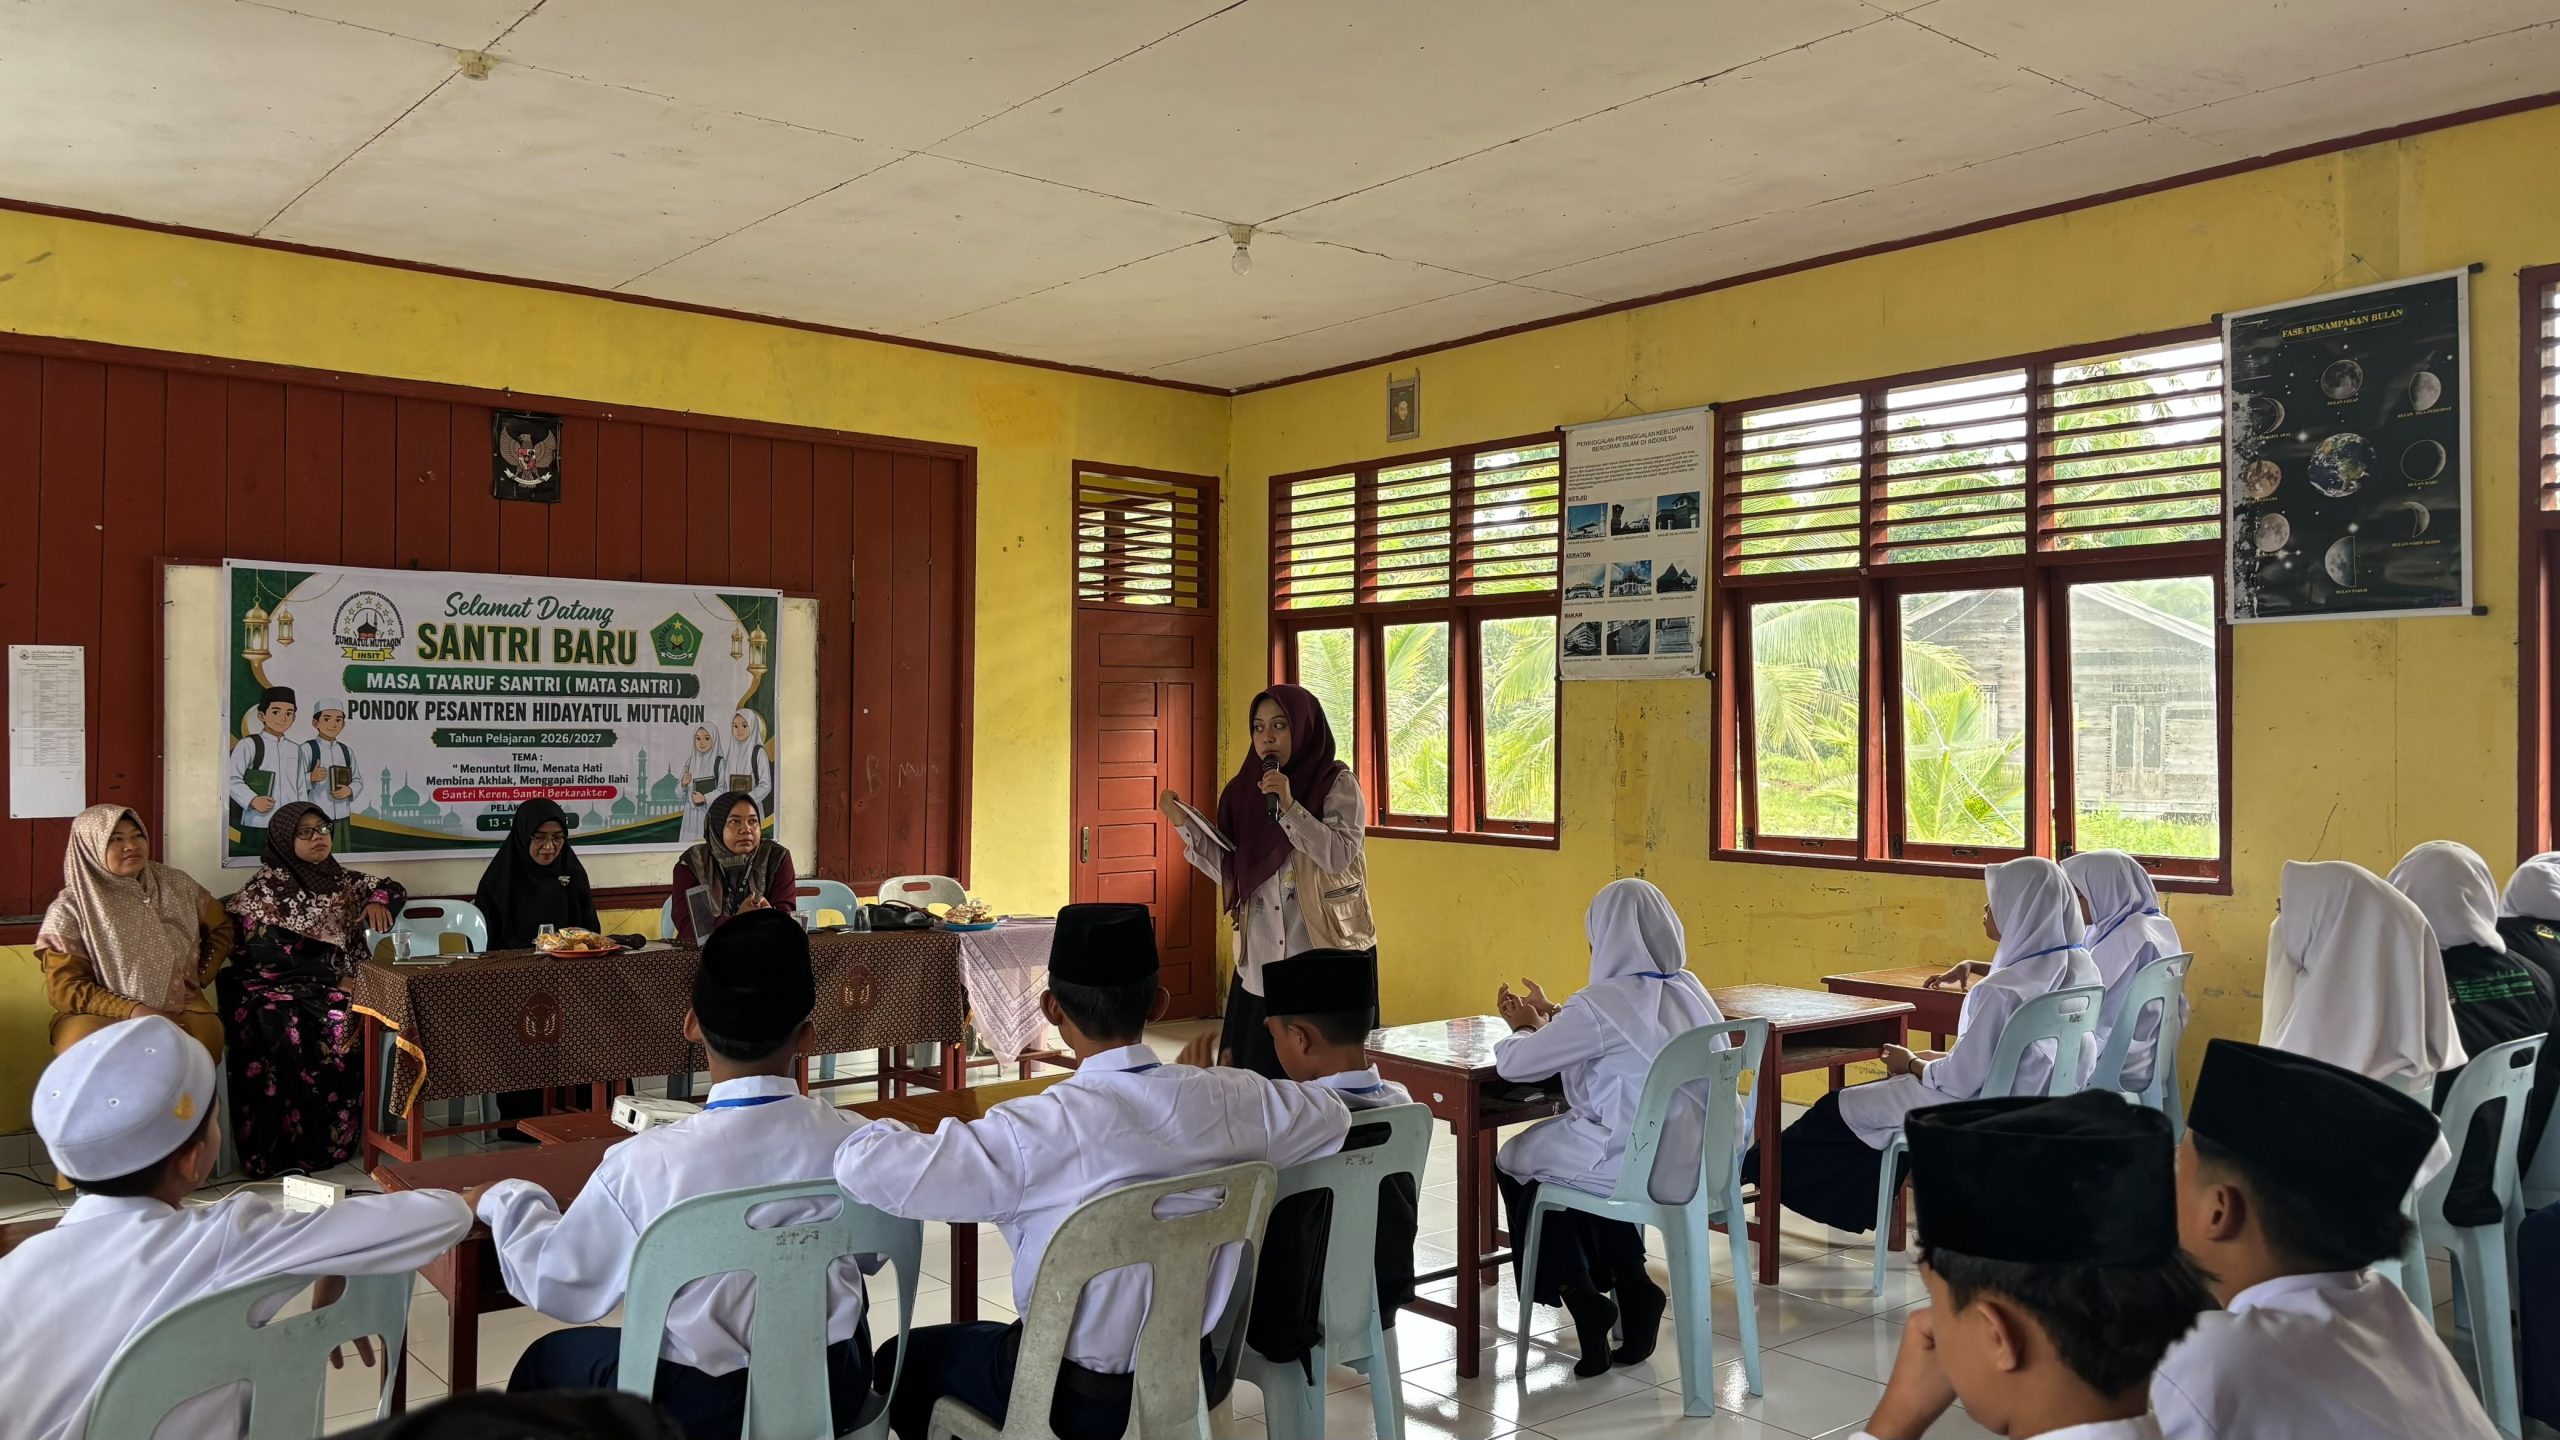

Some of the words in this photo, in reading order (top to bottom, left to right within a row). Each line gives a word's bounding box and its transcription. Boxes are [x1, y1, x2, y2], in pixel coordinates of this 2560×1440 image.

[2281, 327, 2304, 338] FASE
[2305, 315, 2369, 334] PENAMPAKAN
[2371, 308, 2404, 322] BULAN
[444, 591, 533, 618] Selamat
[536, 595, 615, 629] Datang
[335, 635, 369, 647] ZUMRATUL
[417, 623, 541, 663] SANTRI
[554, 627, 638, 666] BARU
[366, 672, 421, 689] MASA
[500, 675, 560, 692] SANTRI
[575, 677, 617, 693] MATA
[620, 678, 673, 695] SANTRI
[347, 699, 419, 721] PONDOK
[425, 700, 527, 722] PESANTREN
[532, 702, 622, 722] HIDAYATUL
[627, 704, 705, 725] MUTTAQIN
[449, 733, 483, 744] Tahun
[486, 733, 536, 746] Pelajaran
[540, 733, 602, 744] 2026/2027
[512, 753, 538, 761] TEMA
[460, 764, 511, 774] Menuntut
[513, 763, 540, 775] Ilmu,
[542, 763, 580, 773] Menata
[582, 763, 603, 773] Hati
[426, 776, 475, 786] Membina
[477, 775, 517, 787] Akhlak,
[519, 775, 575, 787] Menggapai
[577, 775, 606, 785] Ridho
[608, 774, 629, 784] Ilahi
[441, 789, 476, 799] Santri
[513, 788, 546, 799] Santri
[547, 788, 608, 798] Berkarakter
[488, 818, 500, 827] 13
